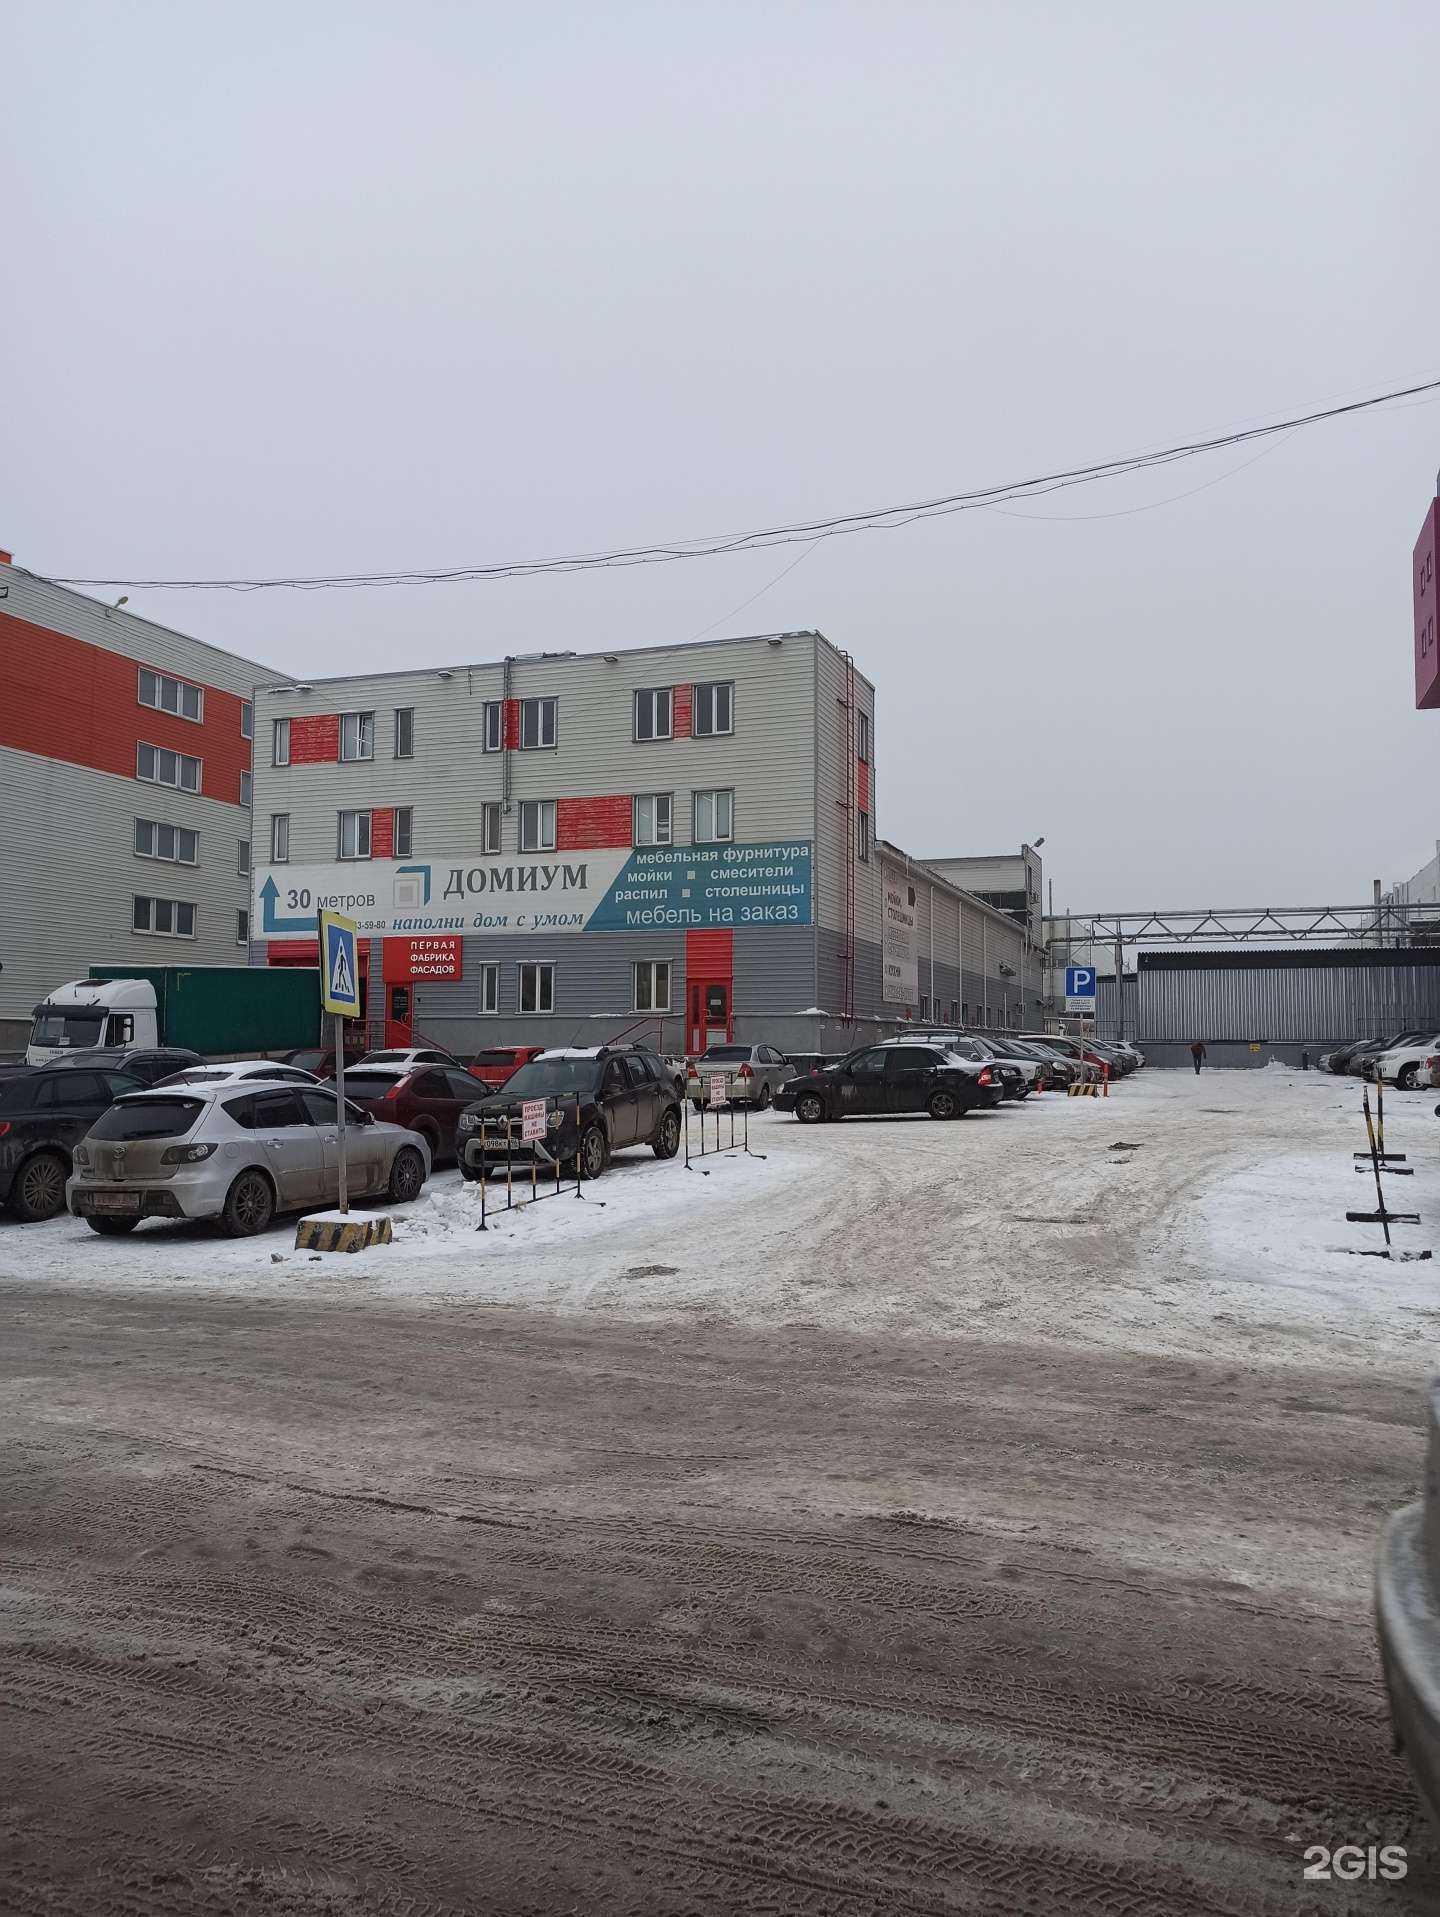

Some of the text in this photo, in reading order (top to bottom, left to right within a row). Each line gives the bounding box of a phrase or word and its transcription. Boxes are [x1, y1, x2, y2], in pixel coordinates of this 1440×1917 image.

[636, 845, 809, 865] мебельная фурнитура
[443, 864, 588, 900] ДОМИУМ
[627, 865, 793, 883] мойки смесители
[287, 888, 376, 911] 30 метров
[615, 884, 805, 904] распил столешницы
[392, 912, 584, 931] наполни дом с умом
[626, 904, 799, 925] мебель на заказ
[354, 920, 386, 930] 3-59-80
[410, 941, 456, 951] ПЕРВАЯ
[410, 952, 456, 962] ФАБРИКА
[410, 964, 456, 975] ФАСАДОВ
[1073, 970, 1090, 994] P
